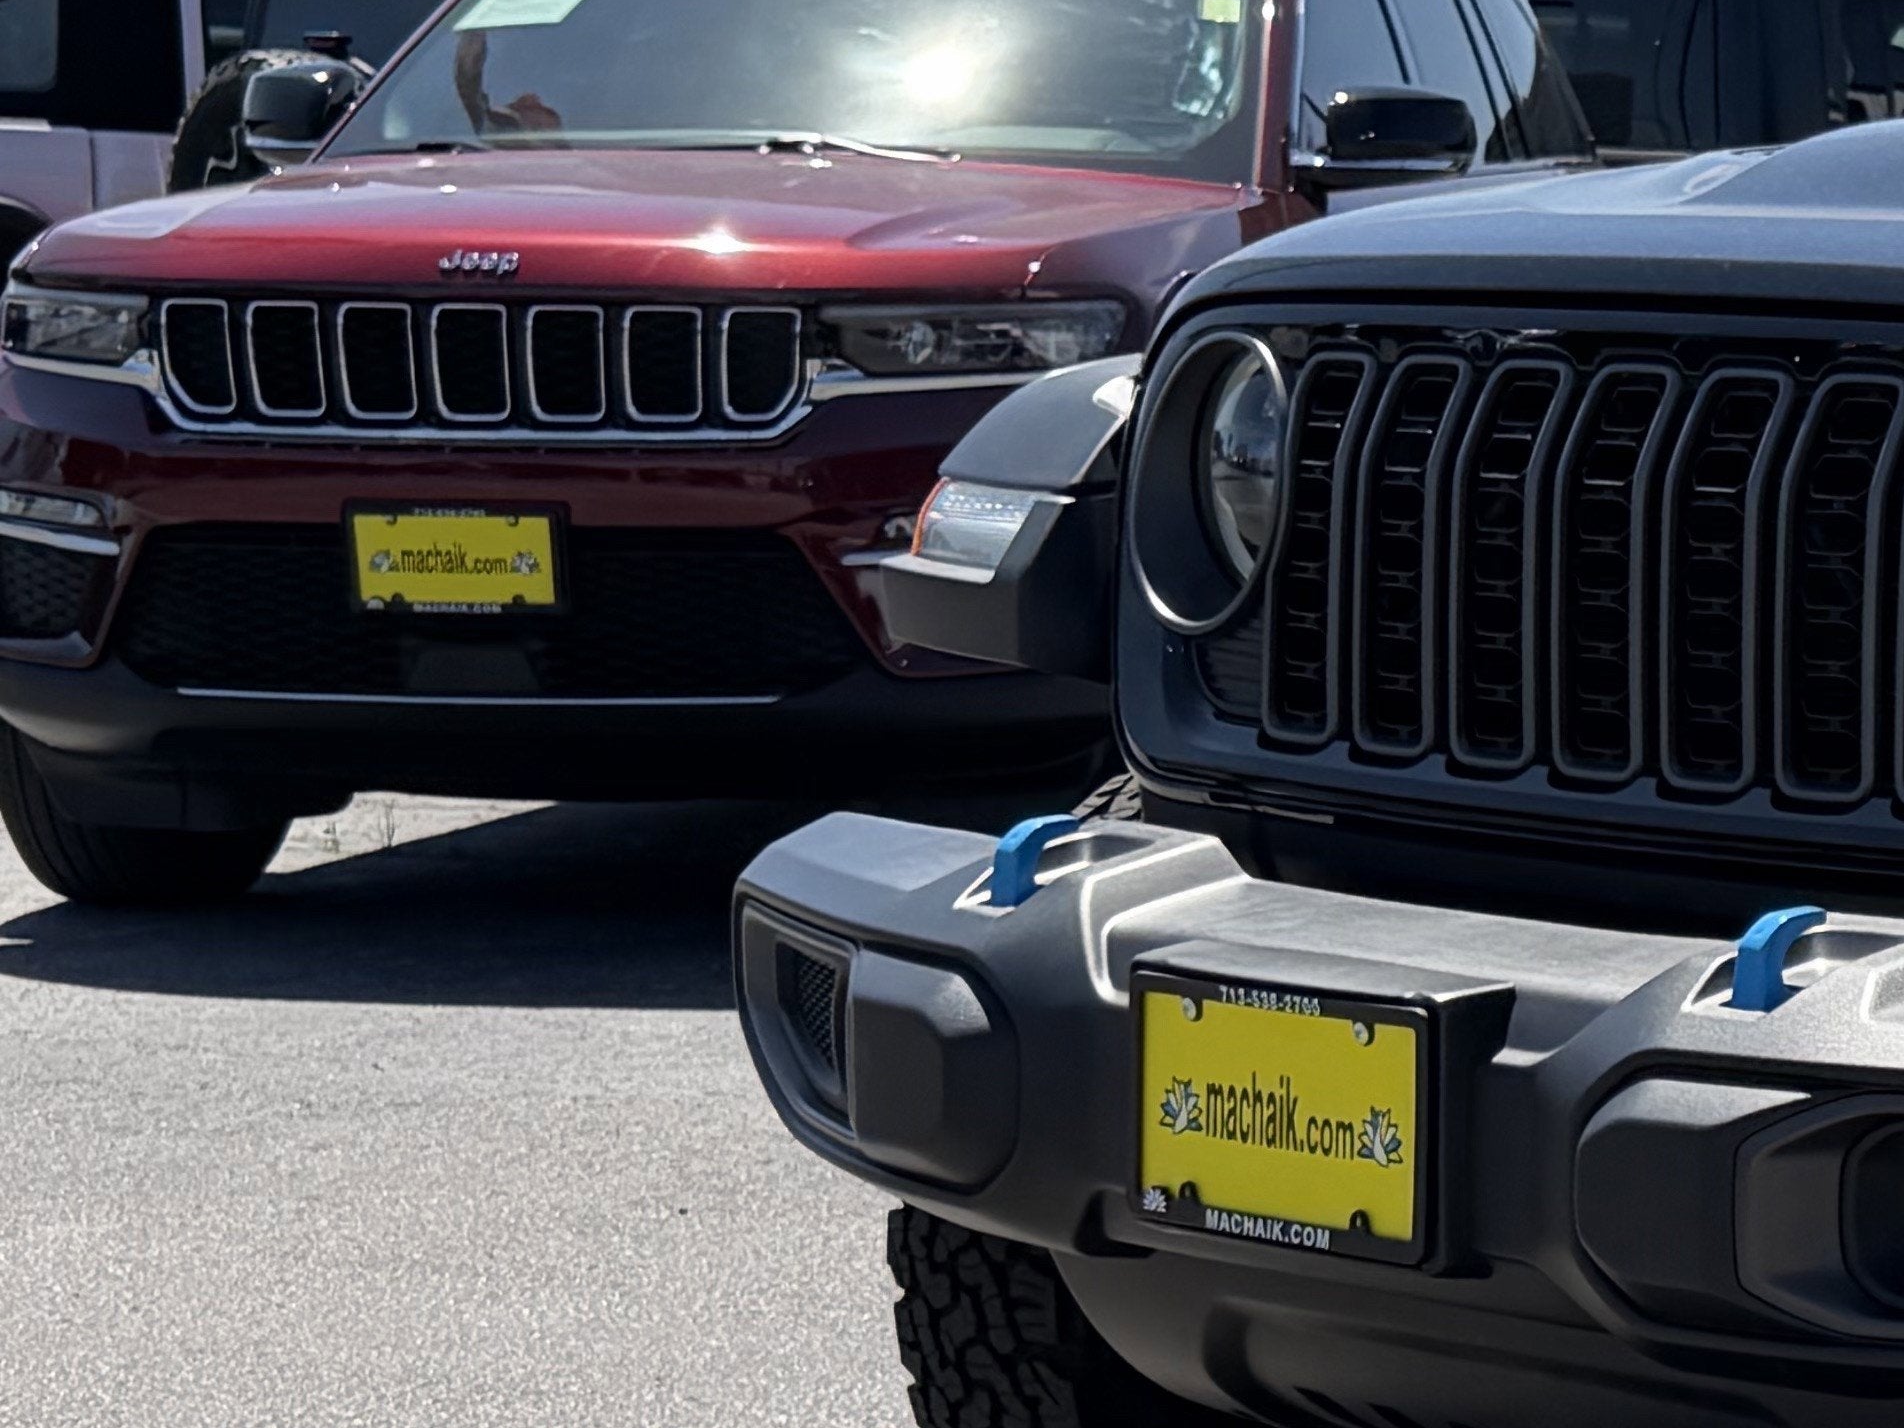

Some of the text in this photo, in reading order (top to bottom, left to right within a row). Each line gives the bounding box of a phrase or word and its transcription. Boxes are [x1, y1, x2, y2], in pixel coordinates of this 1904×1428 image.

[438, 249, 519, 275] Jeep
[1205, 1071, 1355, 1160] machaik.com
[1205, 1208, 1331, 1250] MACHAIK.COM
